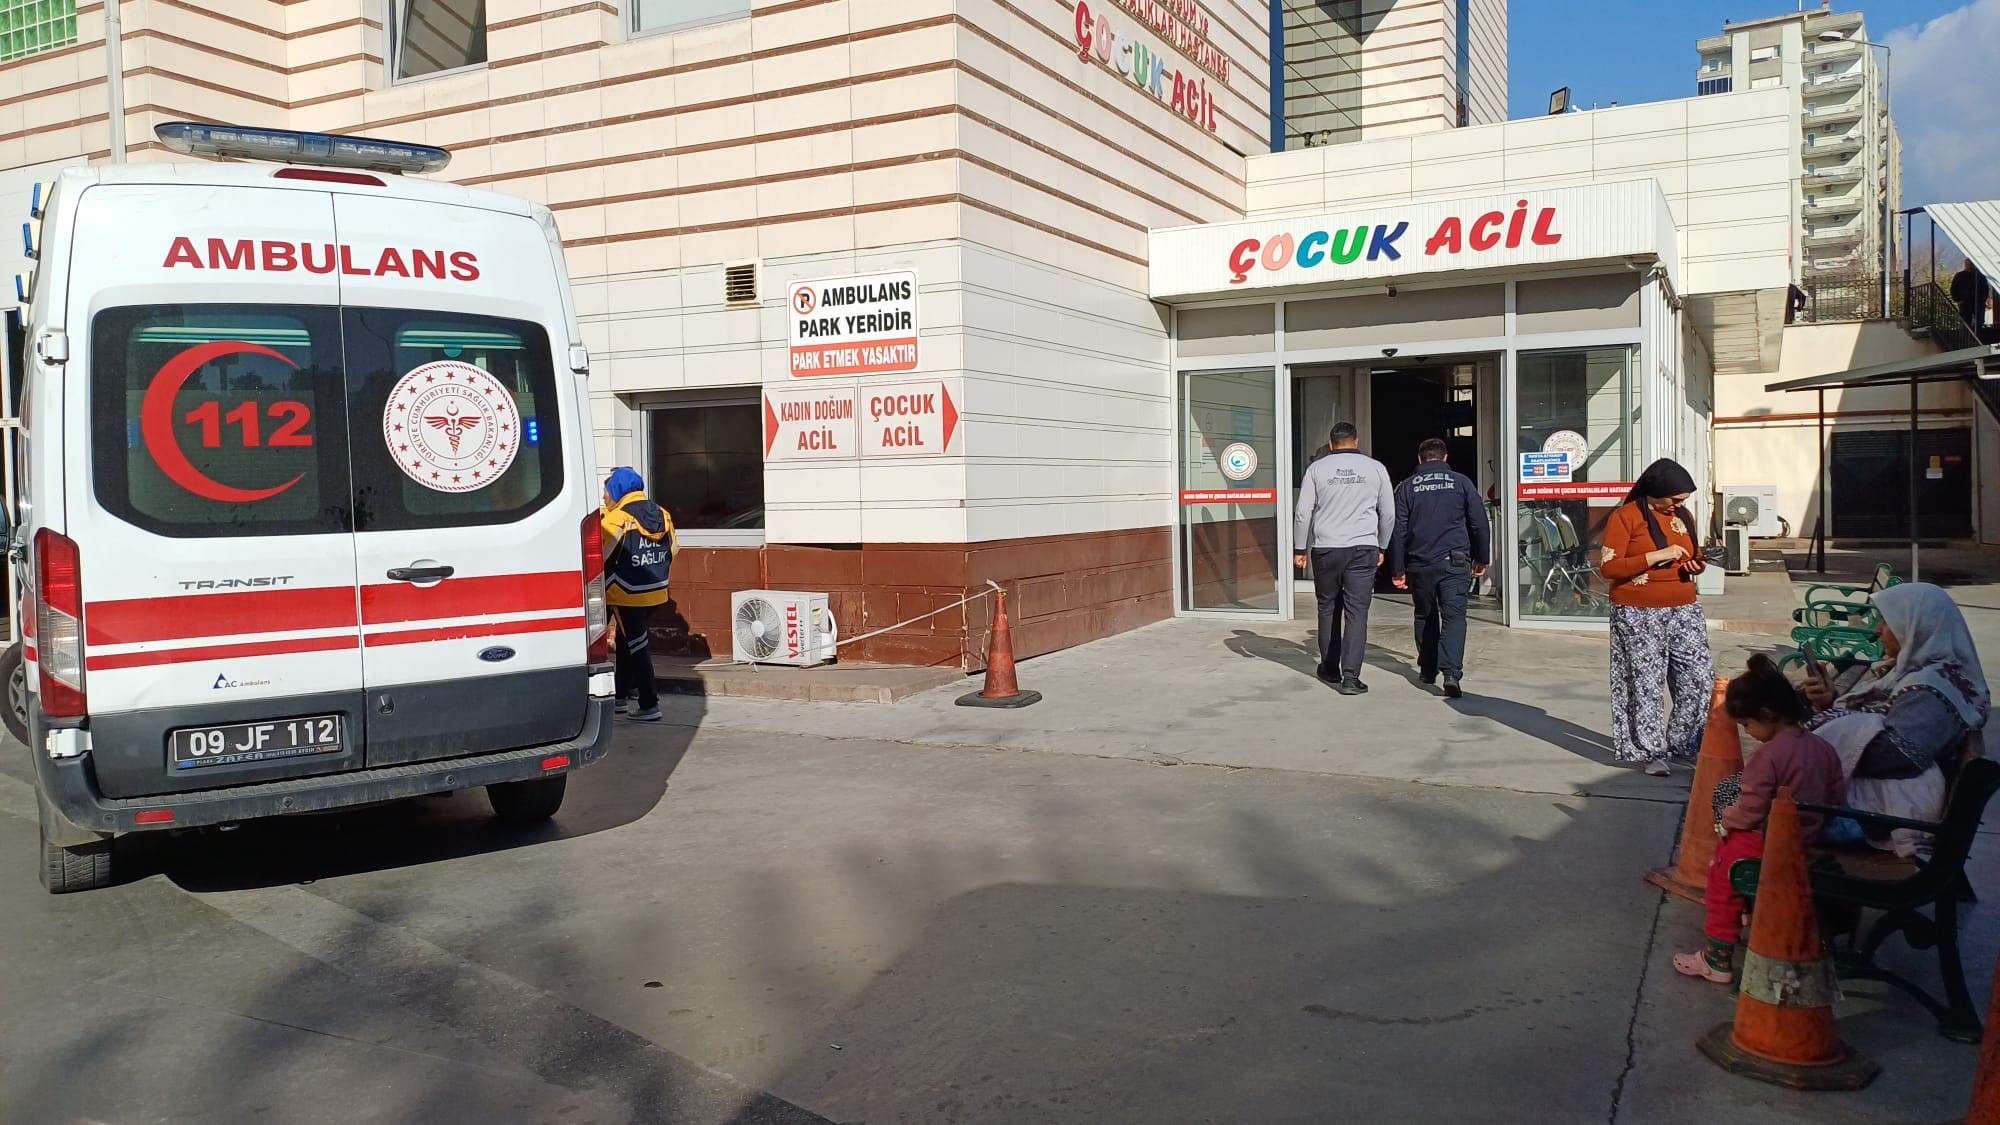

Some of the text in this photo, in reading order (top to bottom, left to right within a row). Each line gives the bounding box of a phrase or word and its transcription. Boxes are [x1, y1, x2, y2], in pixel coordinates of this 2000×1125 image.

[1075, 1, 1217, 131] ÇOCUK ACİL
[1180, 23, 1231, 82] HASTANESİ
[1228, 199, 1563, 284] ÇOCUK ACİL
[163, 236, 481, 281] AMBULANS
[821, 280, 911, 307] AMBULANS
[799, 307, 912, 338] PARK YERİDİR
[792, 344, 916, 370] PARK ETMEK YASAKTIR
[411, 387, 460, 425] CUMHURİYETİ
[462, 390, 489, 413] SAĞLIK
[780, 395, 853, 422] KADIN DOĞUM
[870, 393, 935, 422] ÇOCUK
[185, 401, 313, 448] 112
[475, 416, 494, 461] BAKANLIĞI
[797, 425, 837, 451] ACİL
[882, 421, 924, 447] ACİL
[1413, 481, 1454, 492] GÜVENLİK
[631, 550, 668, 567] SAĞLIK
[178, 576, 294, 590] TRANSIT
[787, 602, 799, 659] VESTEL
[189, 719, 335, 756] 09 JF 112
